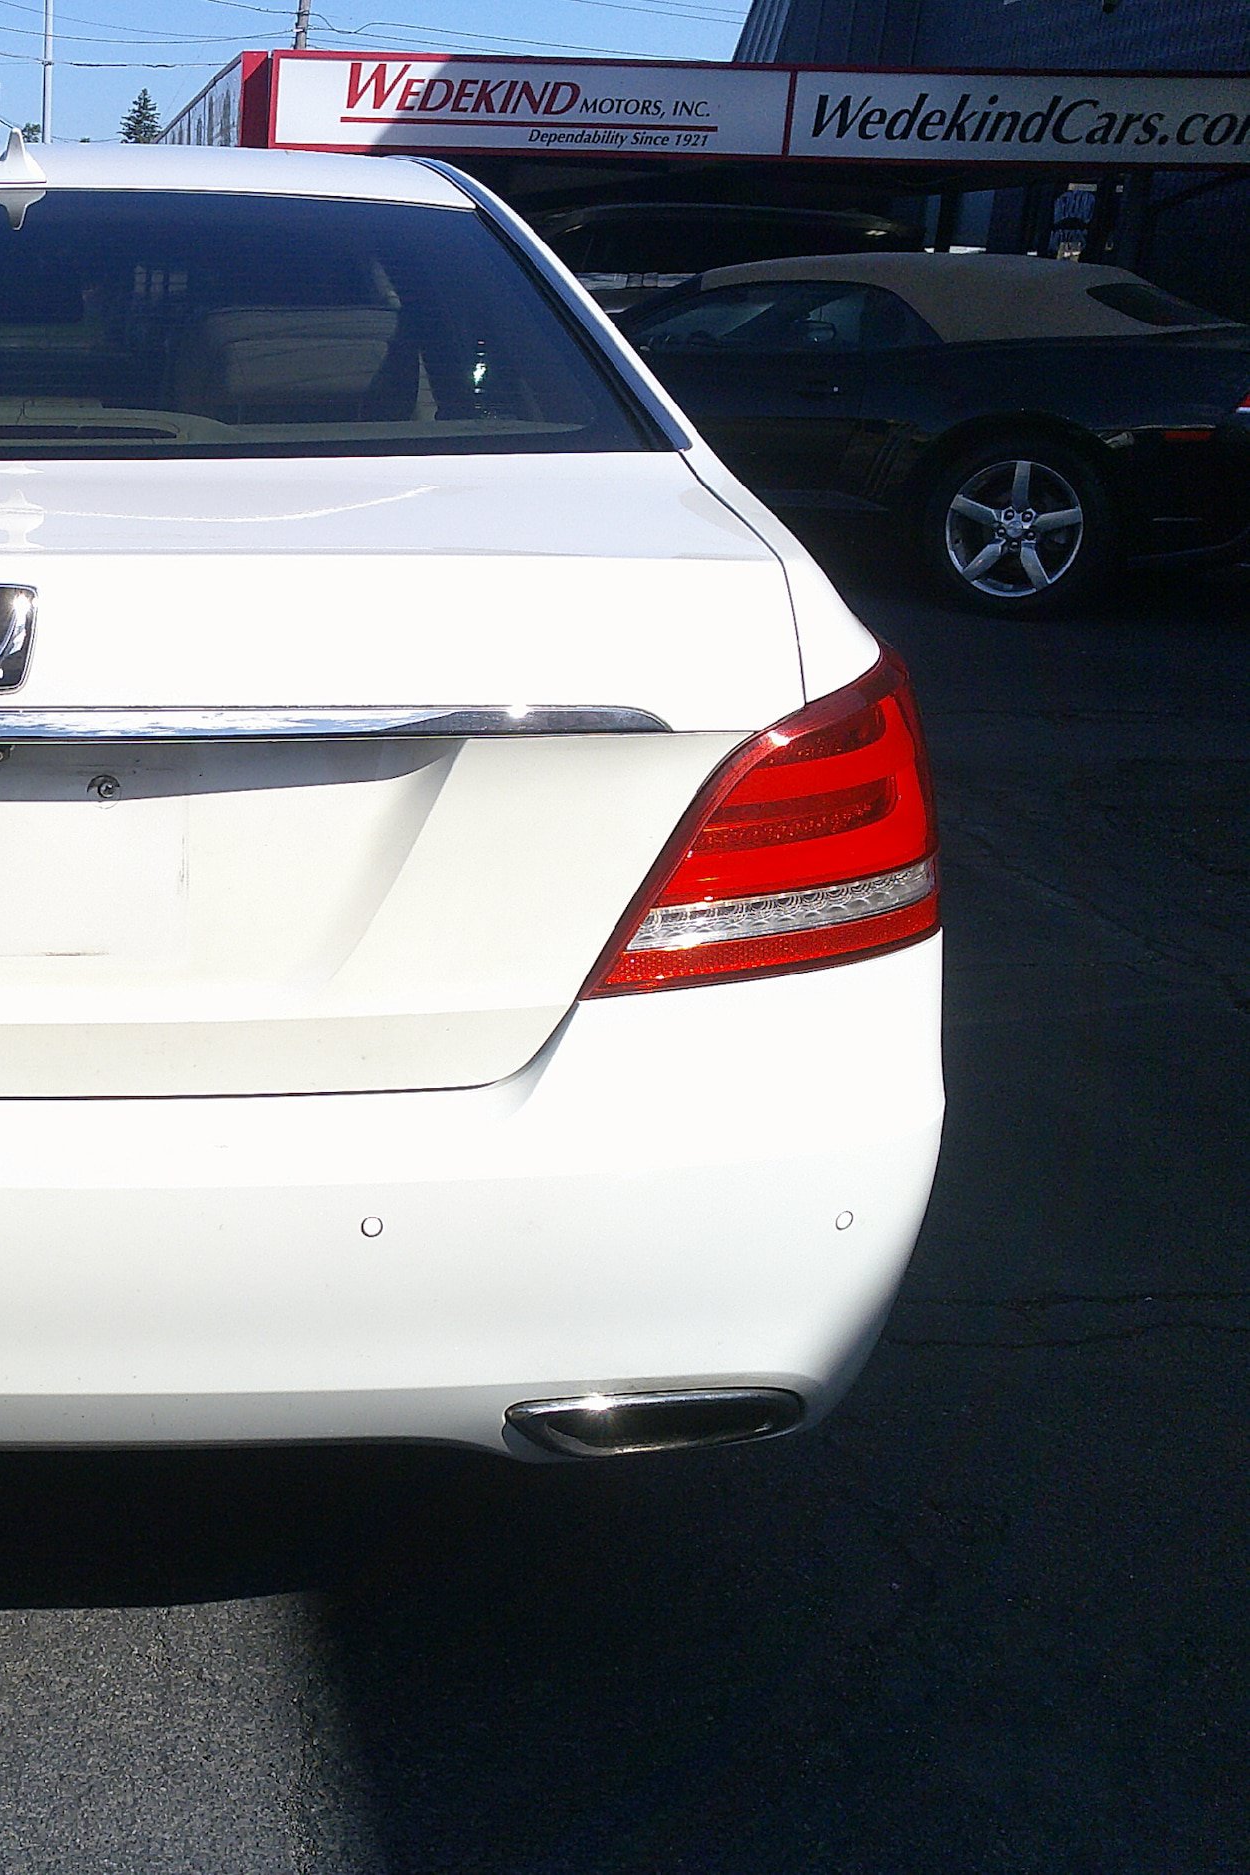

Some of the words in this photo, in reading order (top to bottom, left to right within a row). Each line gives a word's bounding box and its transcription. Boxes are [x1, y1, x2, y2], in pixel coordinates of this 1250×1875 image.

[345, 62, 581, 116] WEDEKIND
[580, 97, 665, 118] MOTORS,
[672, 99, 711, 117] INC.
[528, 129, 628, 148] Dependability
[631, 131, 670, 146] Since
[675, 132, 709, 147] 1921
